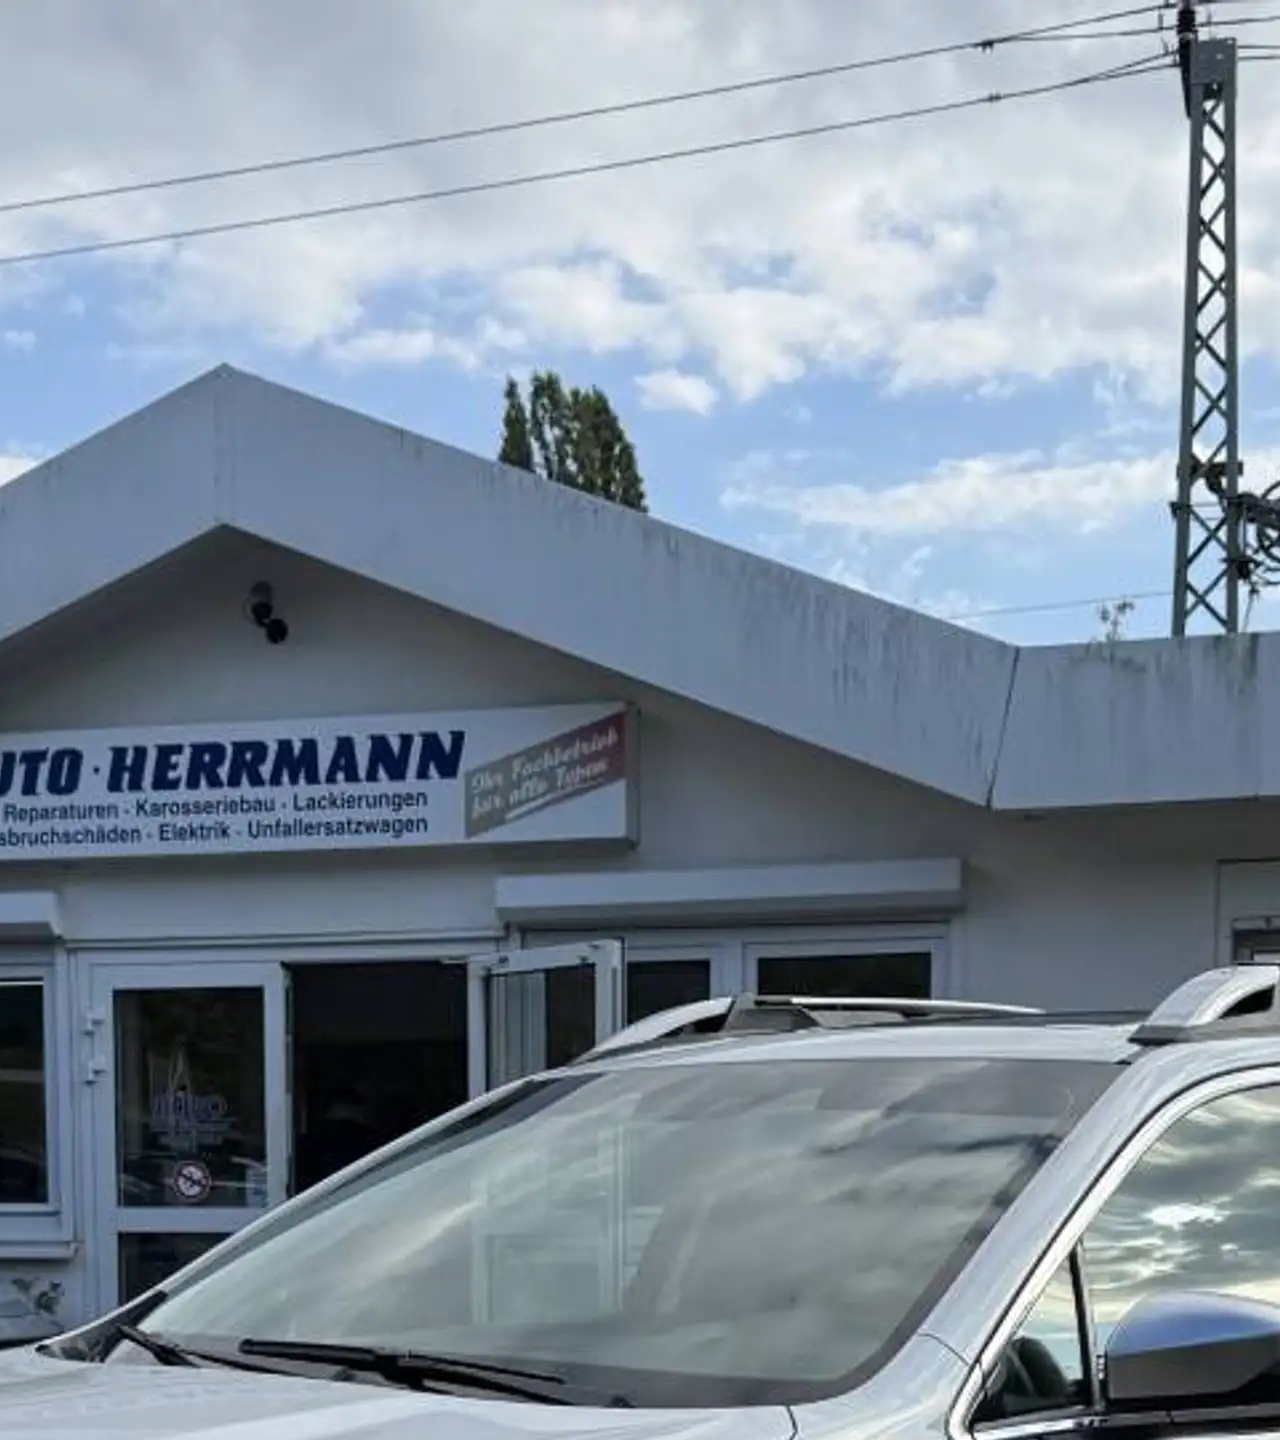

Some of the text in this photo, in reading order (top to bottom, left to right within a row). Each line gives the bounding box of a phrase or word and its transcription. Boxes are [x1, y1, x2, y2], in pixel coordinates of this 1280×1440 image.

[106, 730, 465, 793] HERRMANN
[3, 803, 119, 826] Reparaturen
[135, 792, 276, 819] Karosseriebau
[292, 790, 428, 813] Lackierungen
[159, 821, 231, 842] Elektrik
[247, 816, 428, 840] Unfallersatzwagen
